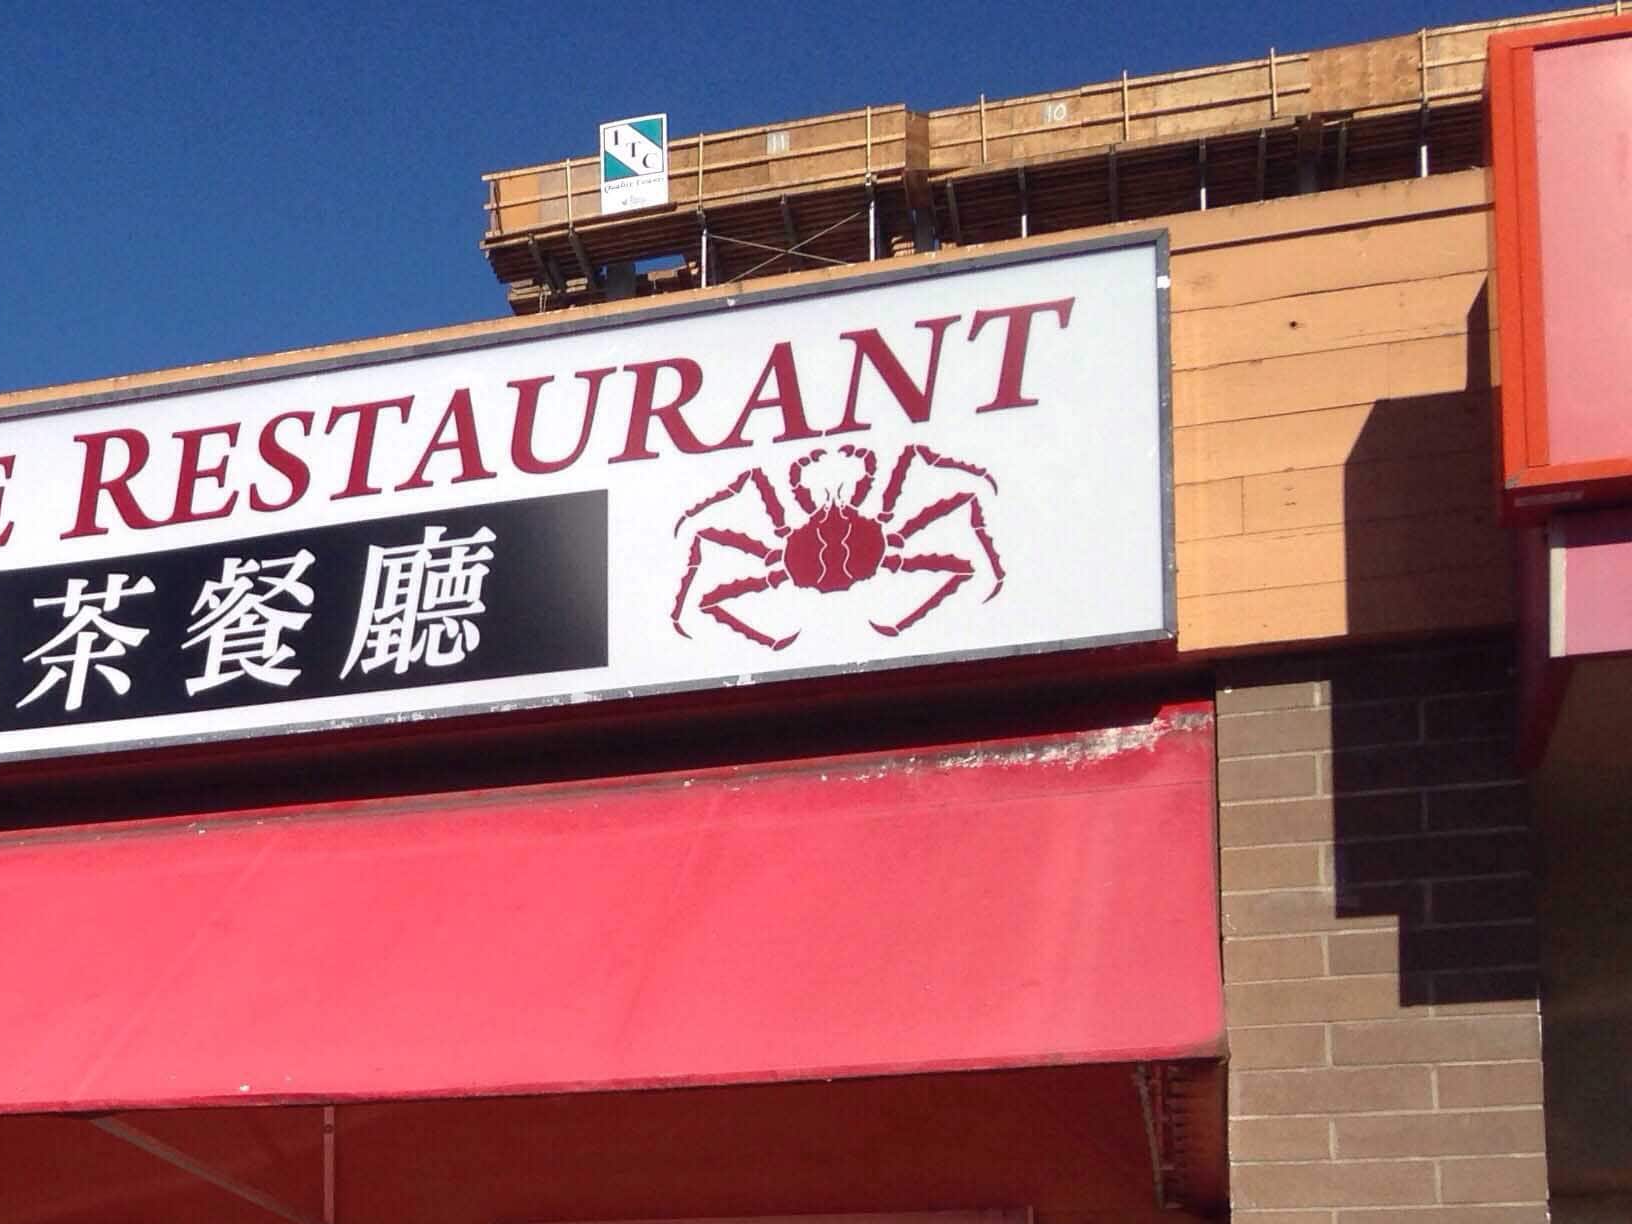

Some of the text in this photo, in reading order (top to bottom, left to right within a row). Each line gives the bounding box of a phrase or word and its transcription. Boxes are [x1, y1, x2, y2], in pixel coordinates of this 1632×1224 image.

[1047, 103, 1066, 123] 10
[614, 129, 659, 169] ITC
[58, 296, 1077, 540] RESTAURANT
